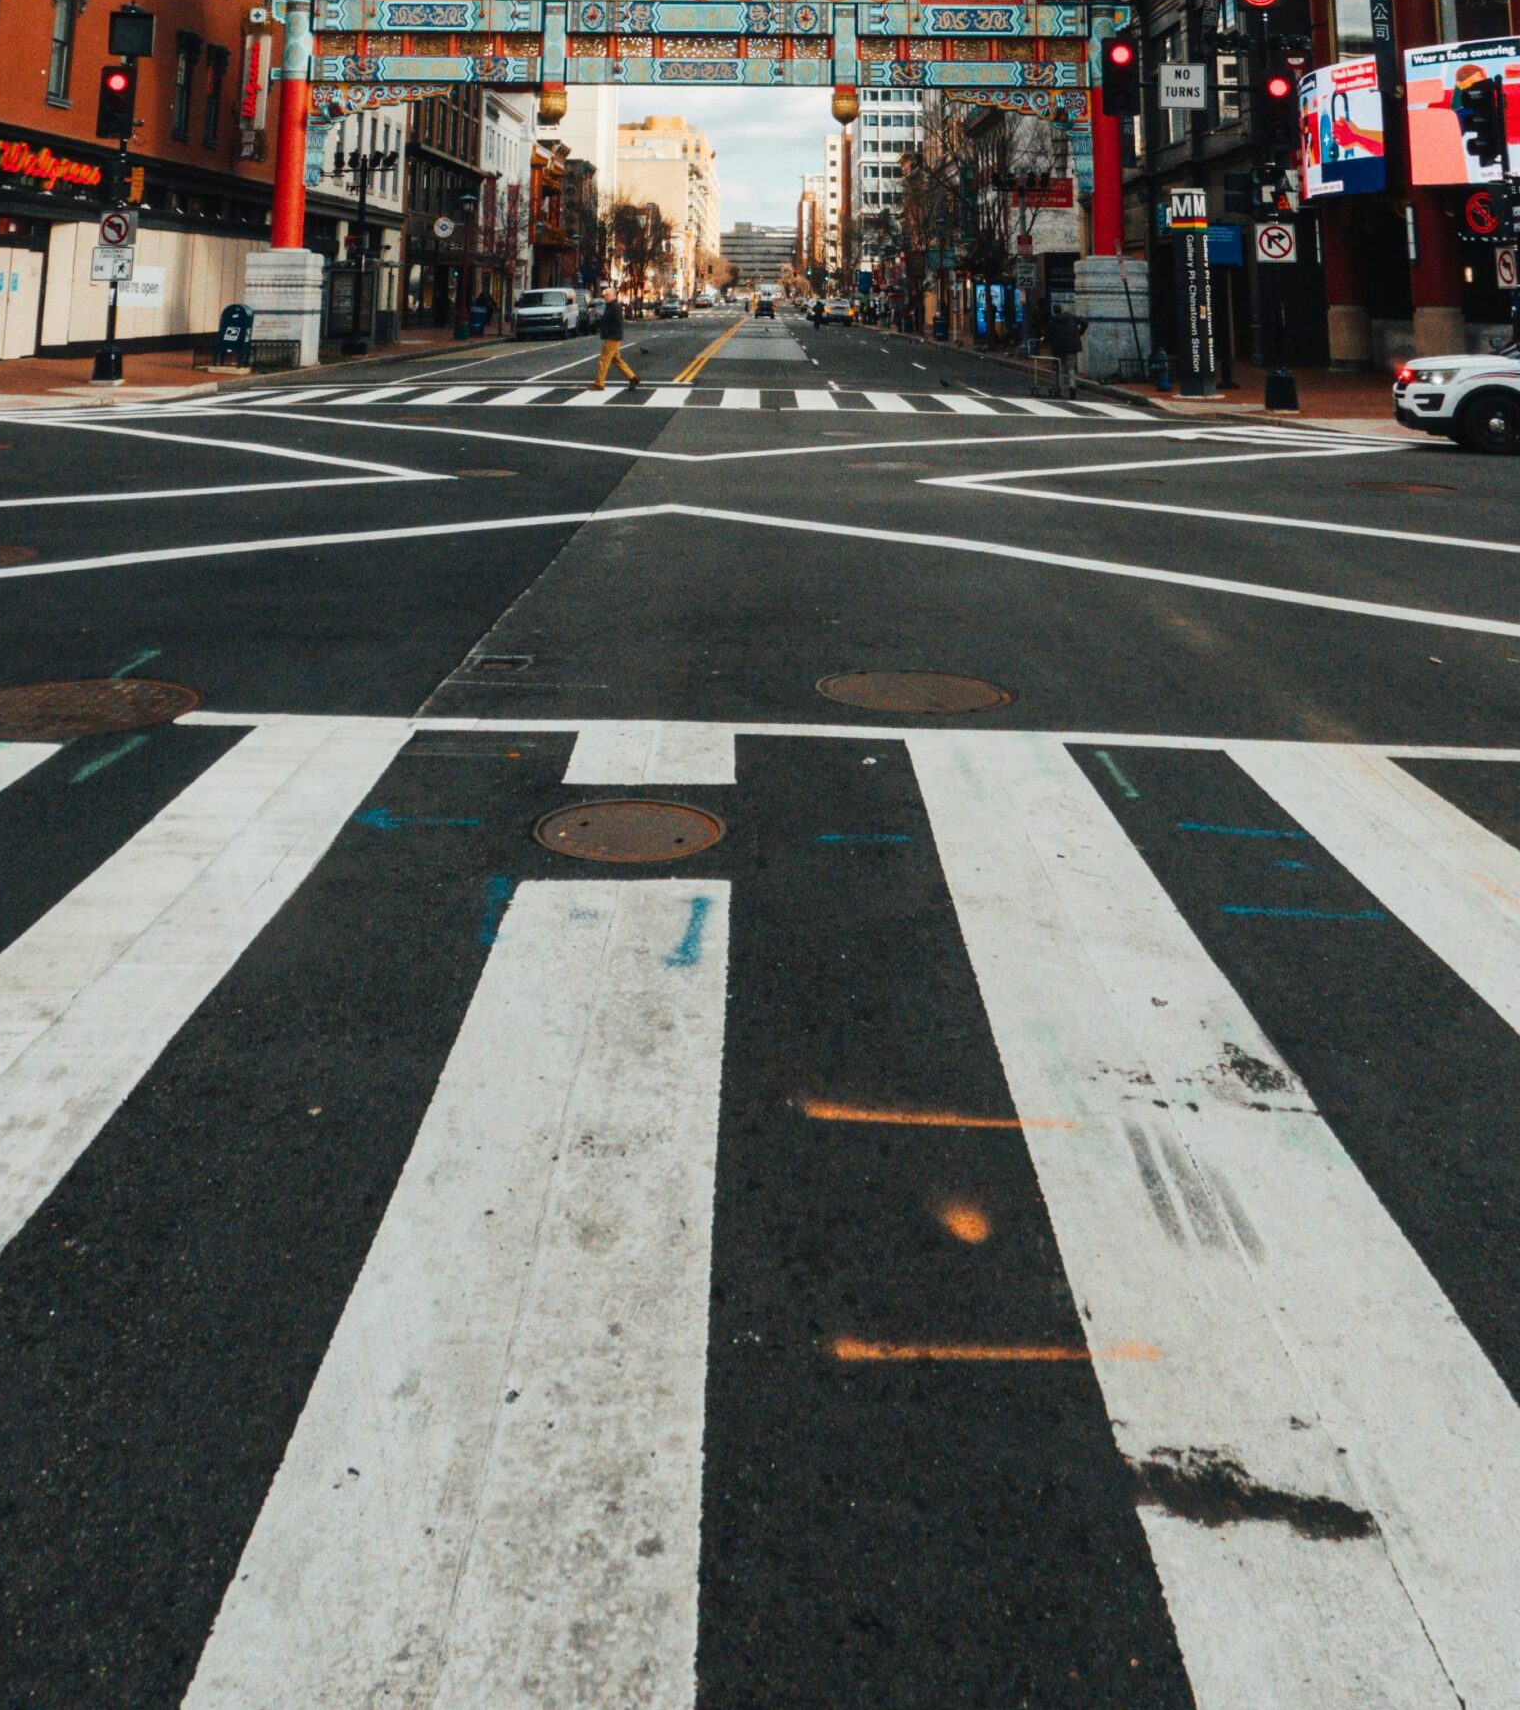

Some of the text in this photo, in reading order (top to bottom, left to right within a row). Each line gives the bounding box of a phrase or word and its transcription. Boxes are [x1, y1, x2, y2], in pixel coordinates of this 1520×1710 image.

[1413, 45, 1517, 65] Wear a face covering
[1174, 69, 1191, 80] NO
[1165, 86, 1201, 98] TURNS
[1171, 194, 1192, 217] M
[1193, 194, 1206, 217] M
[1019, 276, 1034, 287] 25
[1185, 234, 1195, 268] Gallery
[1191, 337, 1200, 373] Station
